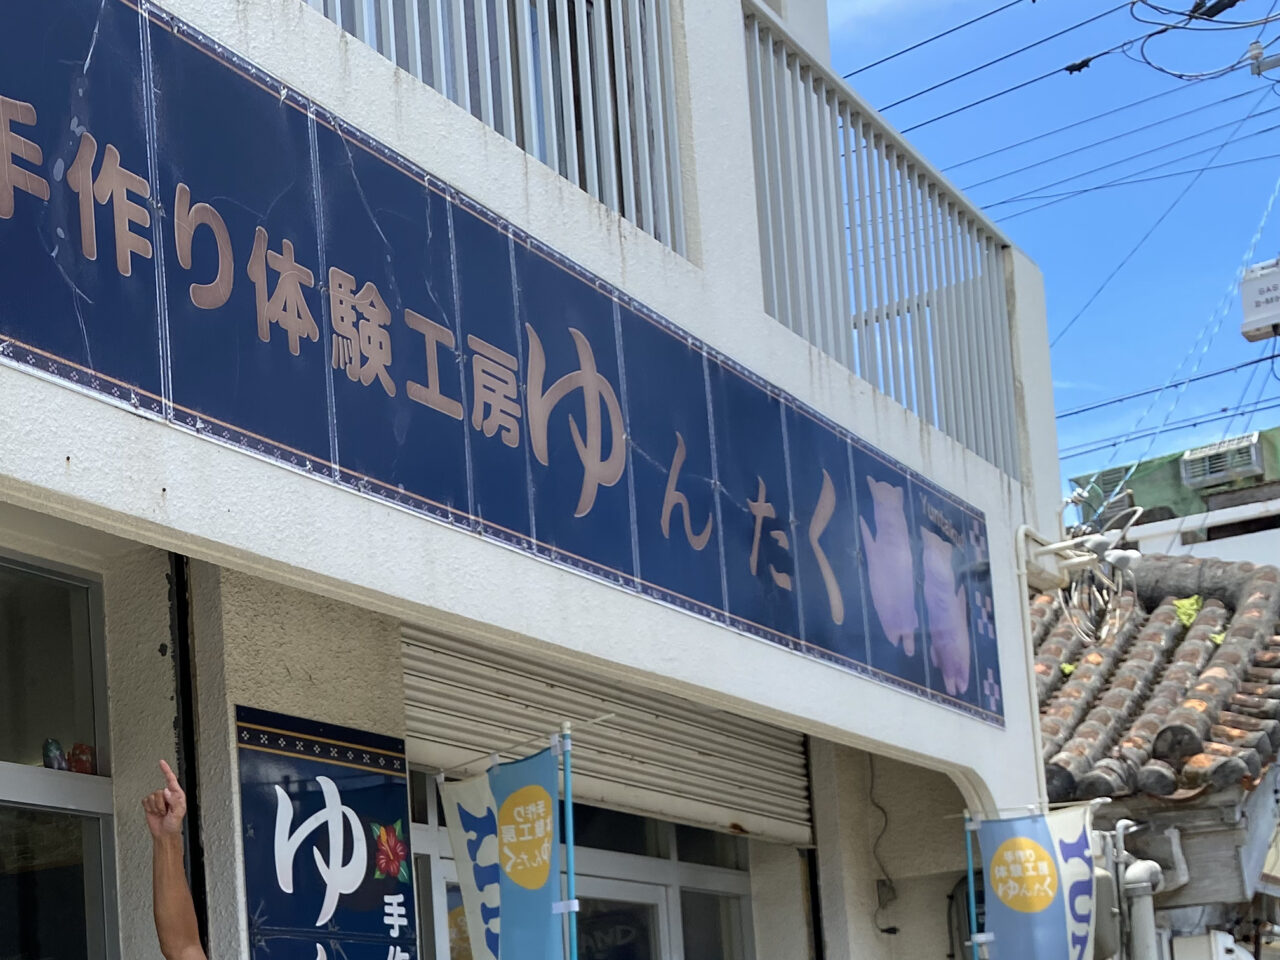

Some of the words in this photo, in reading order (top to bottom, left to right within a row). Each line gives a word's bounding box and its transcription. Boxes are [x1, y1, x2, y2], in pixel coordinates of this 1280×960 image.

[525, 322, 845, 626] ゆんたく
[1004, 847, 1036, 863] 手作り
[998, 877, 1054, 900] ゆんたく
